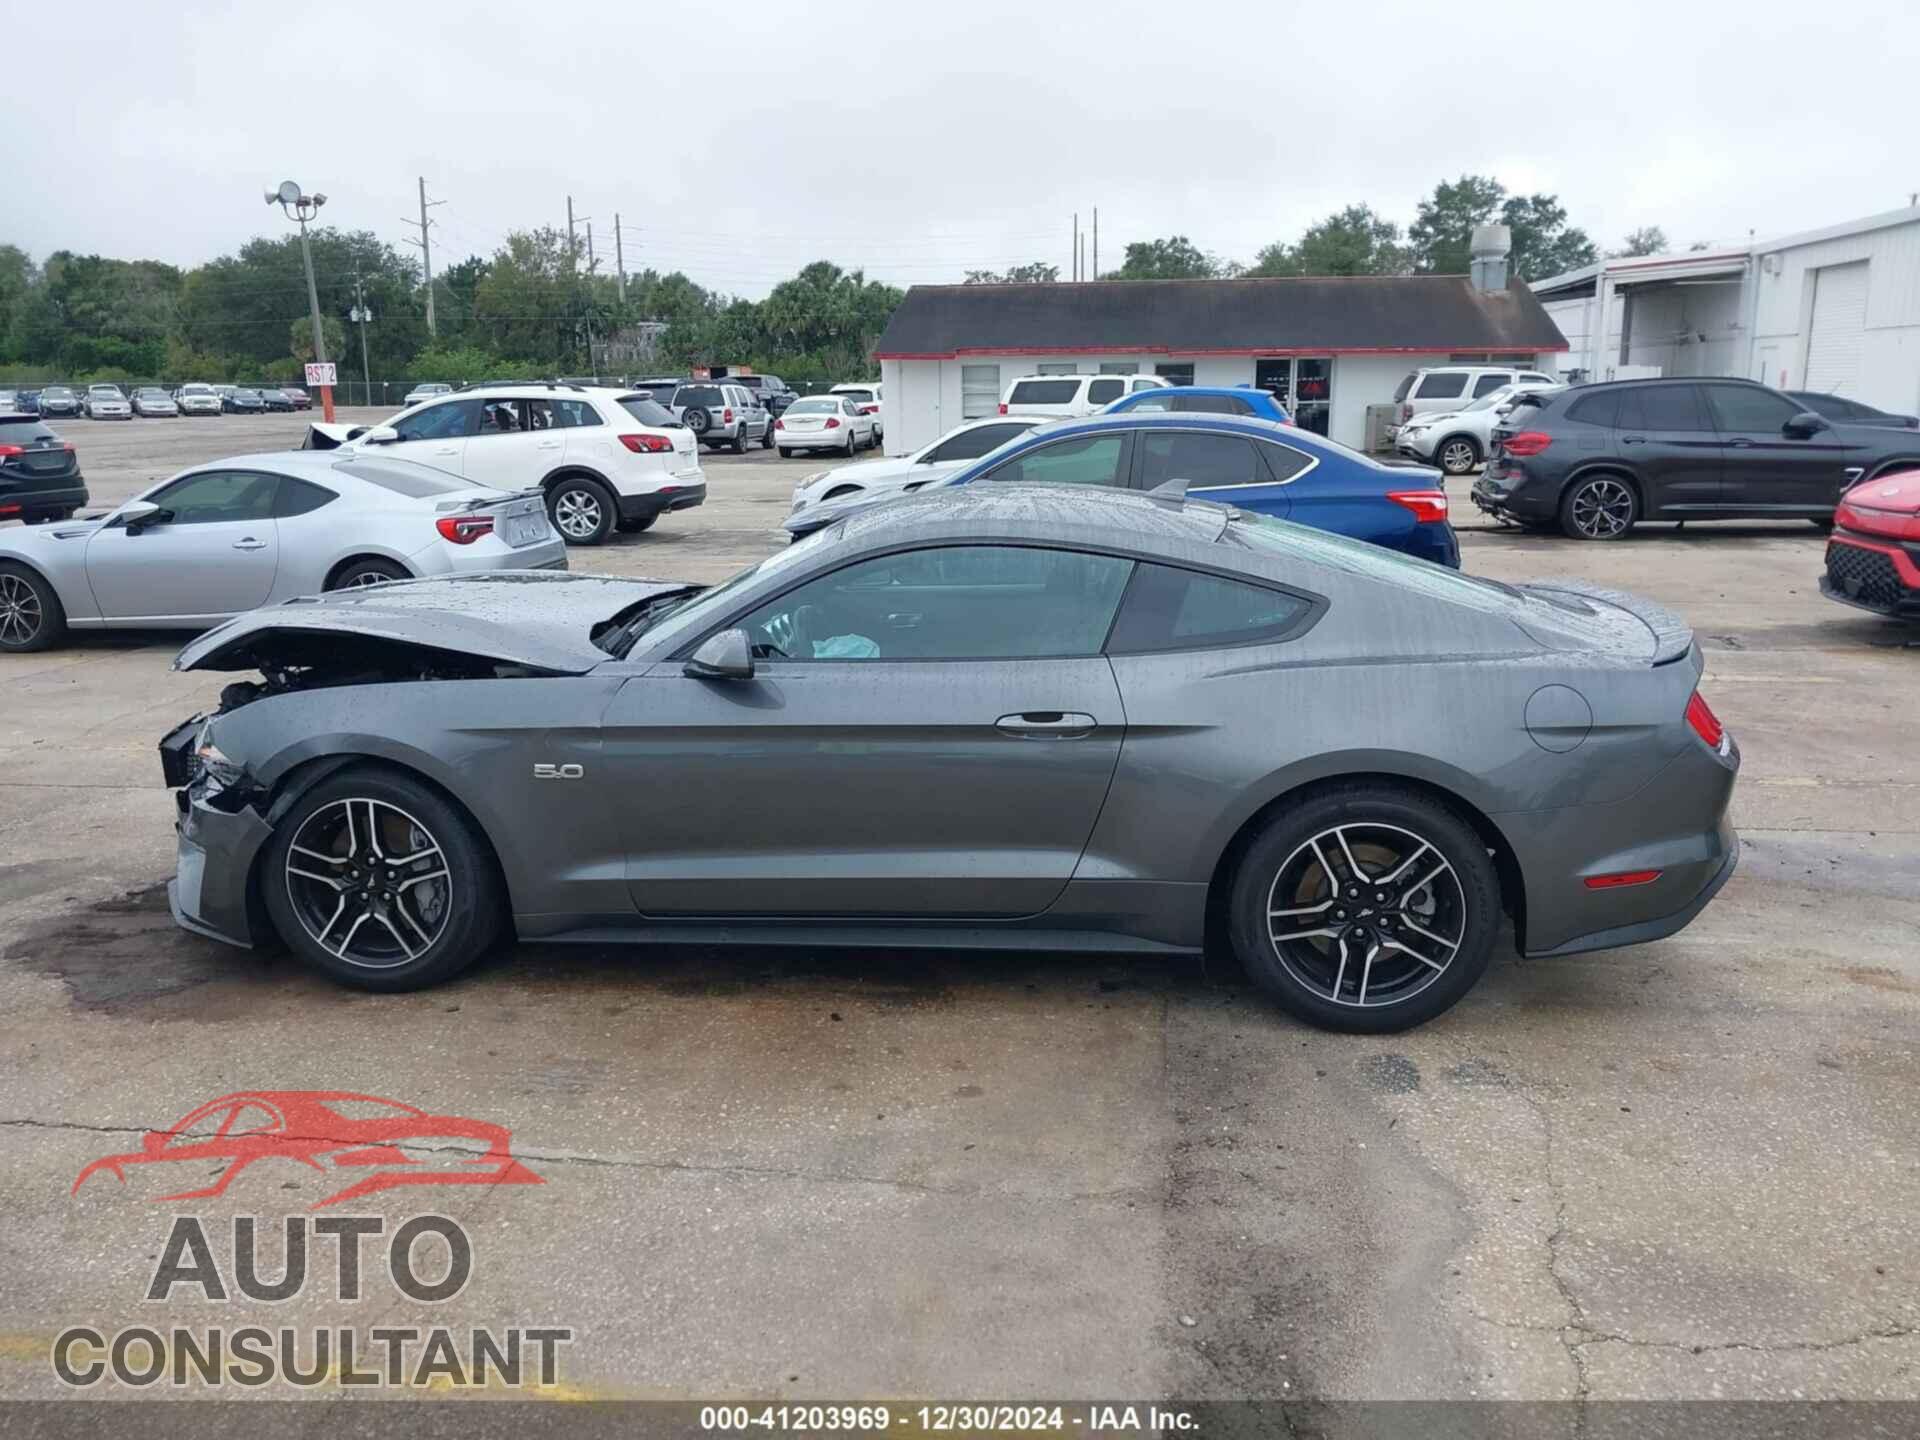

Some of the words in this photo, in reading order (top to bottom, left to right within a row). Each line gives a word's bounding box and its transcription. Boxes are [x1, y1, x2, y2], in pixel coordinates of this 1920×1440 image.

[306, 365, 325, 382] RST
[328, 366, 336, 382] 2
[534, 763, 584, 779] 5.0
